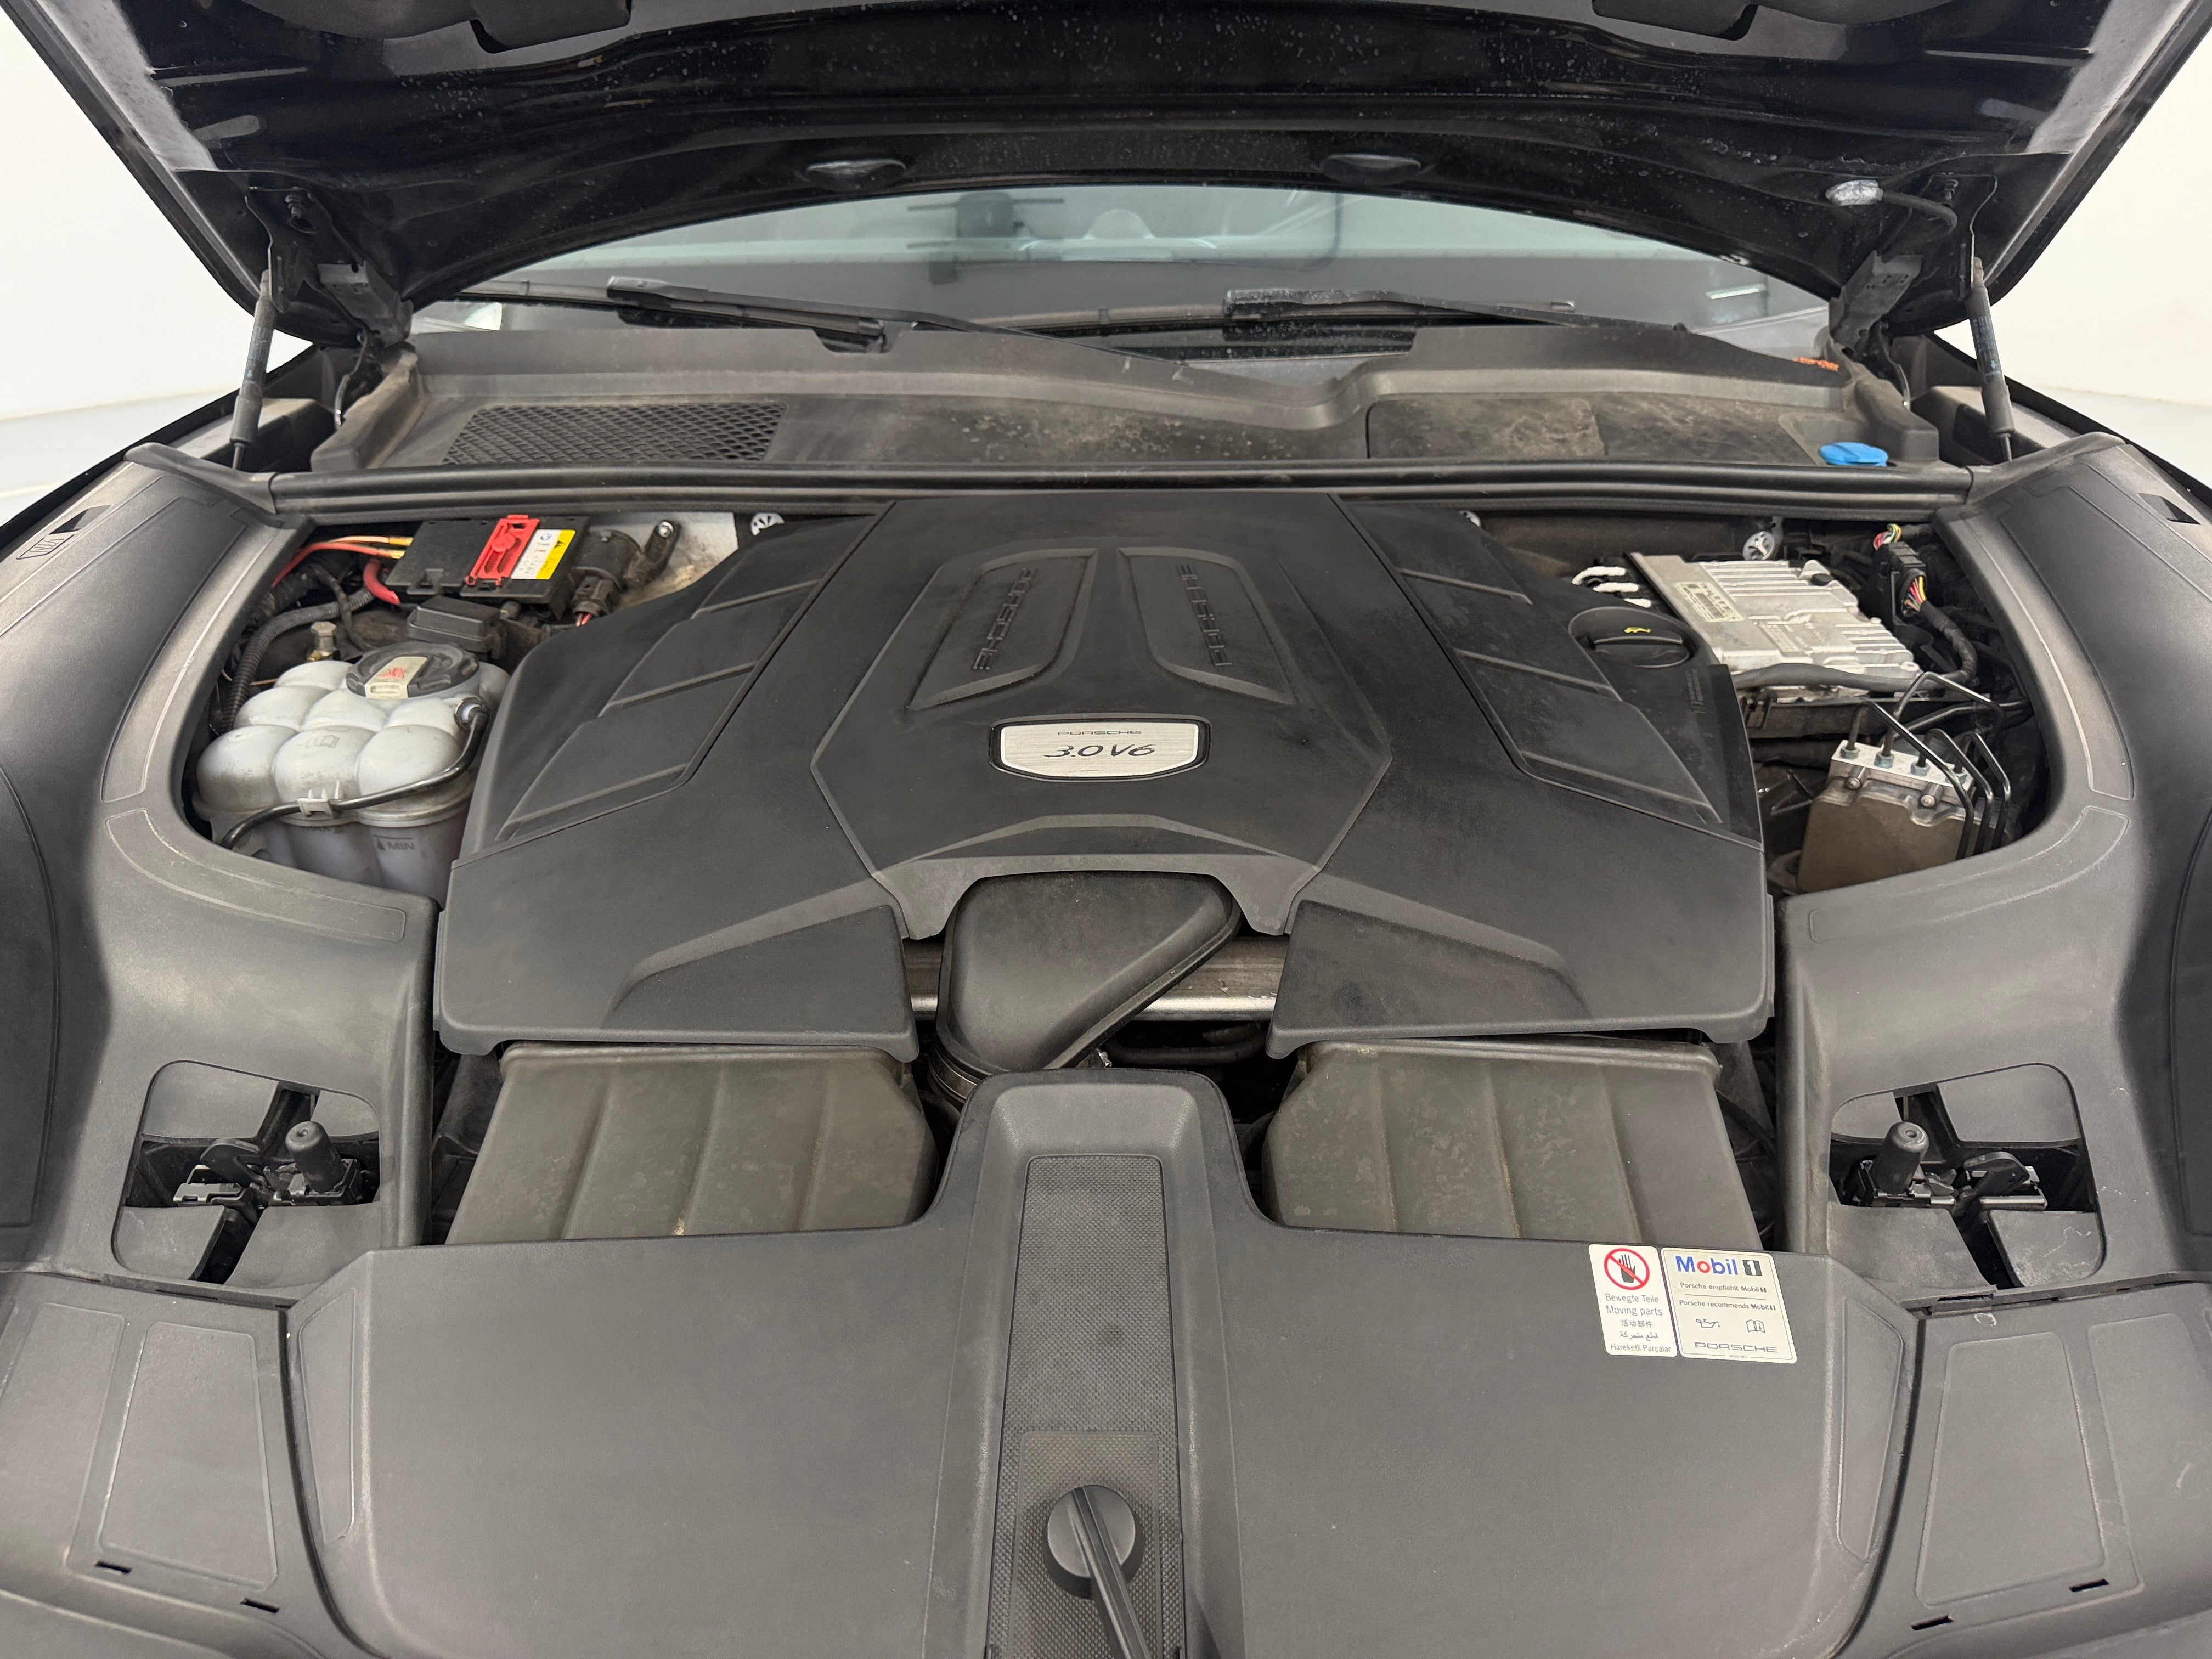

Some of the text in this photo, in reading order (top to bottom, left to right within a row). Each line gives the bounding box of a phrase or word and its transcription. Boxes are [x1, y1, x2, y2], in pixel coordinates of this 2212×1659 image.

[973, 567, 1038, 670] PORSCHE
[1176, 565, 1233, 667] PORSCHE
[387, 841, 415, 850] MIN
[1675, 1255, 1739, 1276] Mobil
[1708, 1283, 1739, 1292] empfiehlt
[1605, 1293, 1659, 1304] Bewegte Teile
[1606, 1305, 1663, 1317] Moving parts
[1620, 1319, 1653, 1328] 活动部件
[1619, 1330, 1658, 1341] قطع متحركة
[1610, 1343, 1672, 1353] Hareketli Parçalar
[1694, 1342, 1779, 1353] PORSCHE
